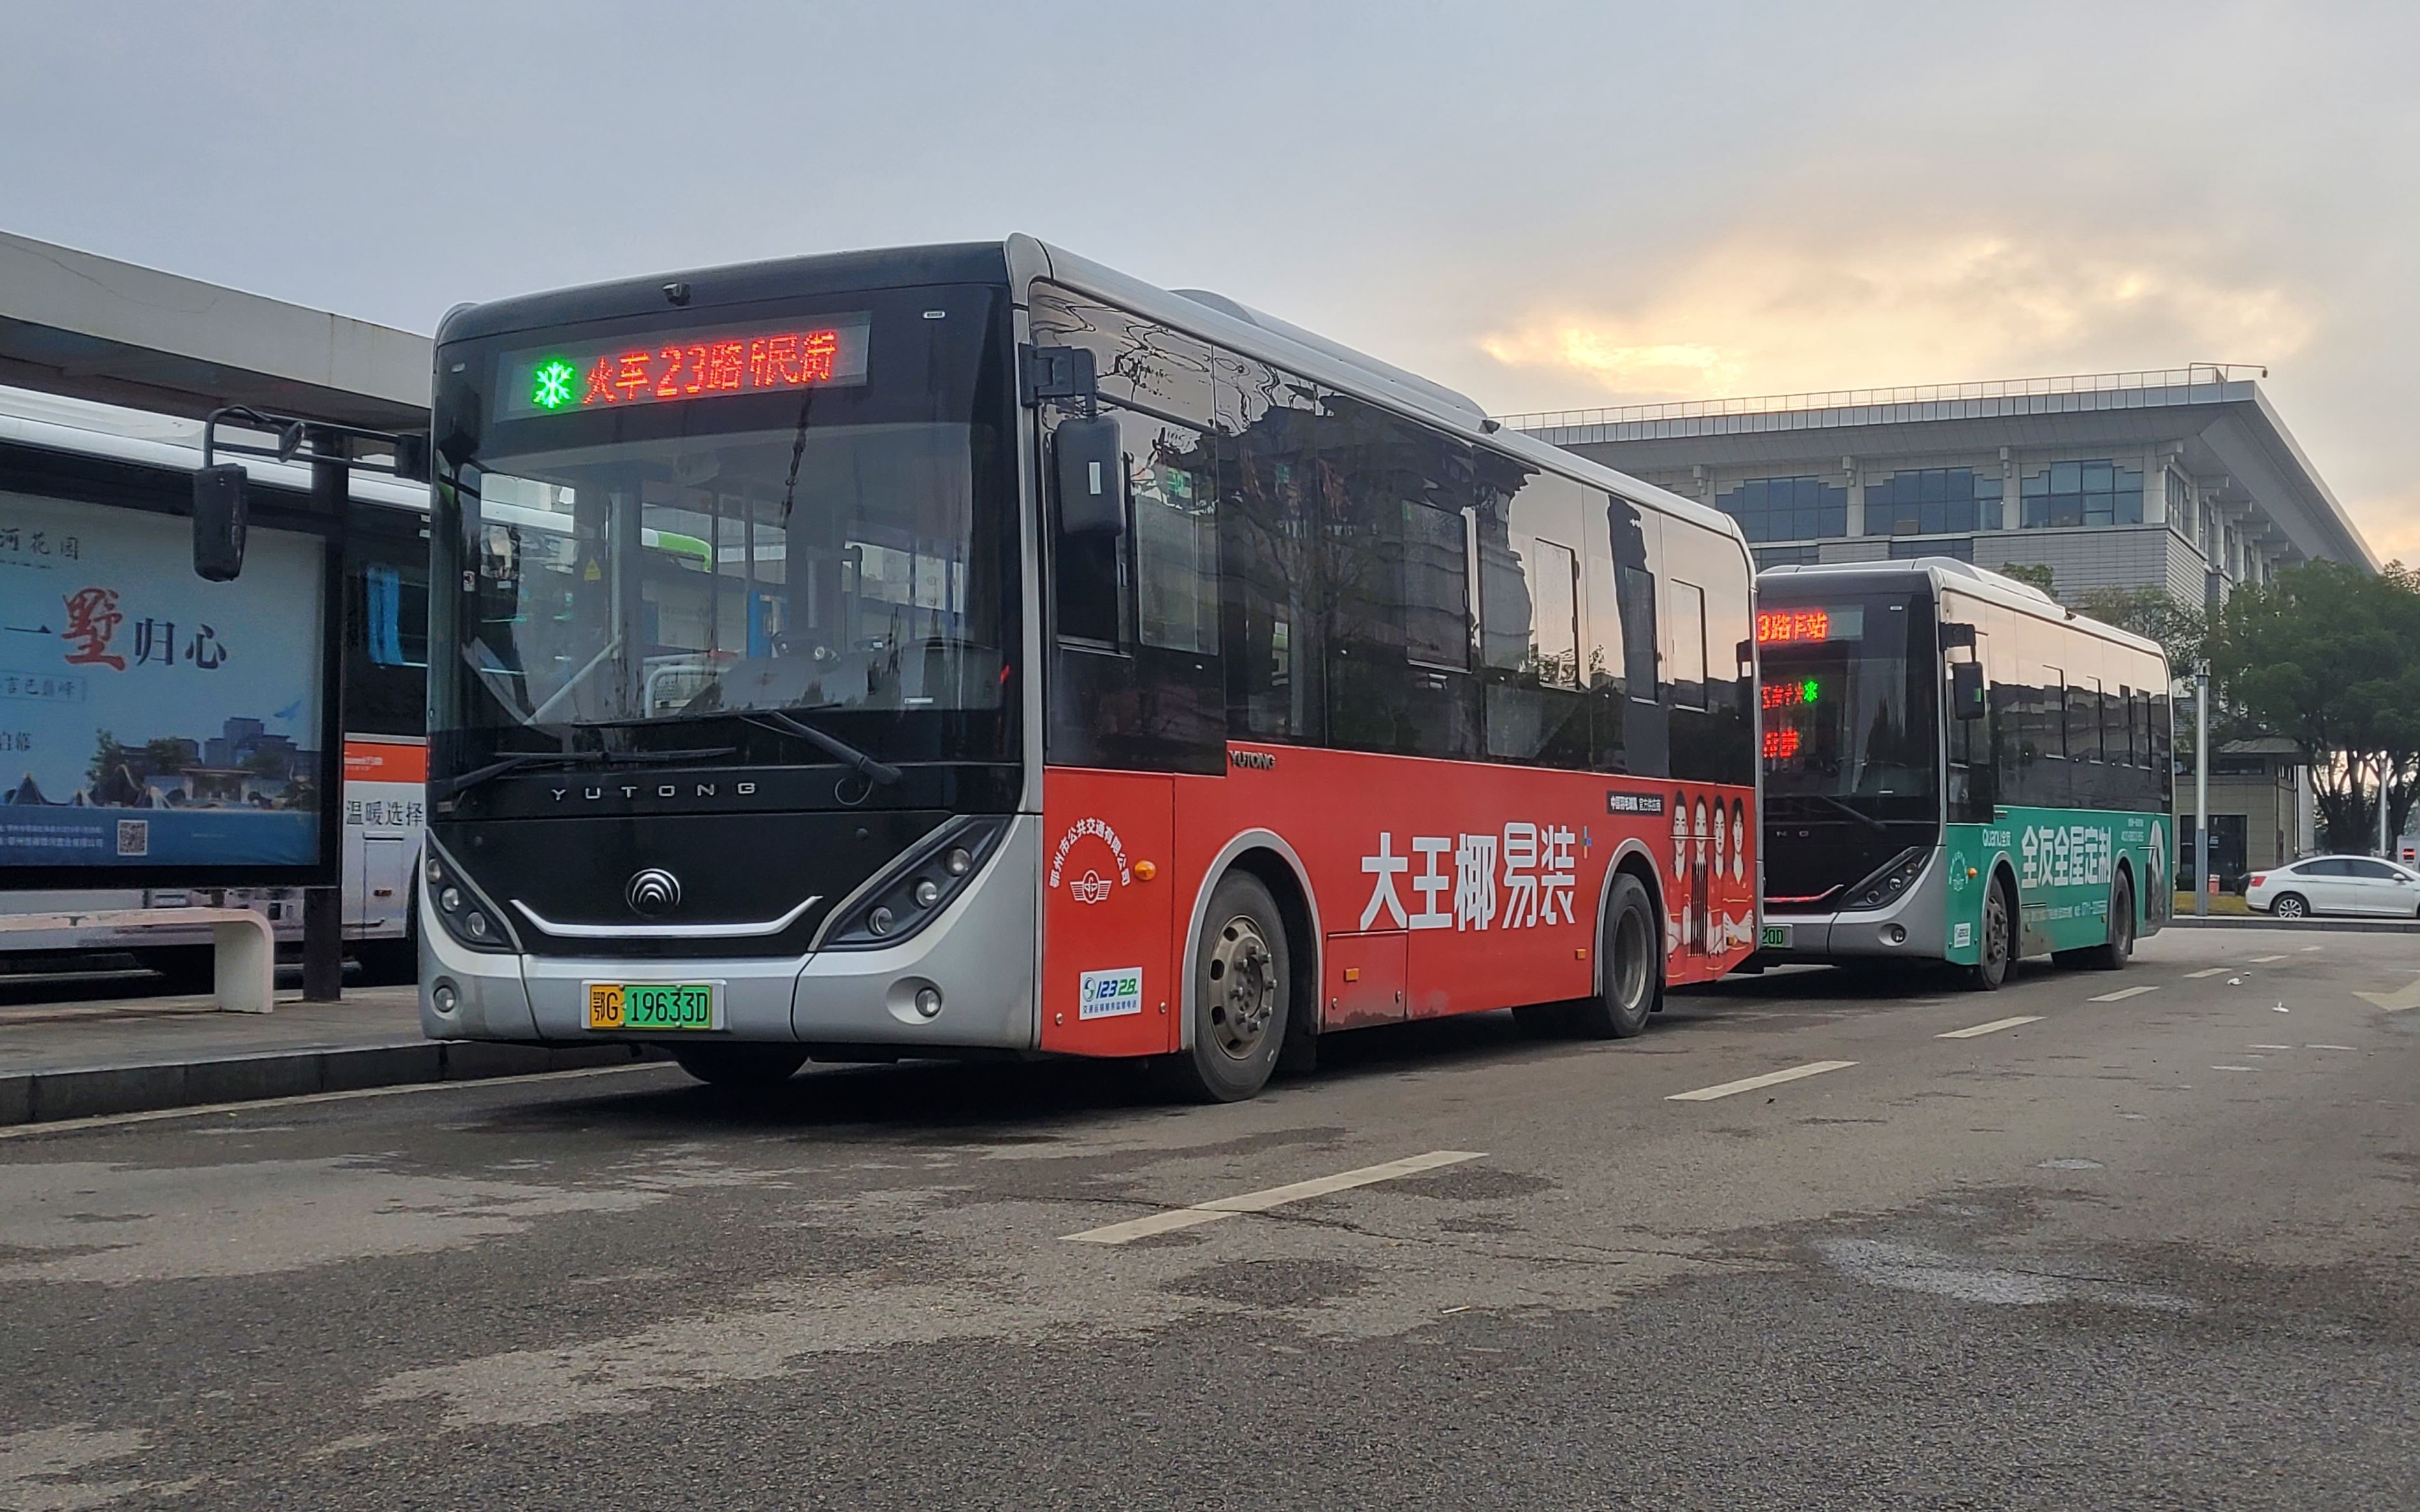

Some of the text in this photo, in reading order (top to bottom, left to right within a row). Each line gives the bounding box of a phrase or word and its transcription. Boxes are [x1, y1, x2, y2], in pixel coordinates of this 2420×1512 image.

[1228, 750, 1276, 770] YUTONG
[552, 783, 756, 800] YUTONG
[346, 800, 423, 826] 温暖选择
[2021, 825, 2111, 889] 全友全屋定制
[1360, 822, 1575, 932] 大王椰易装
